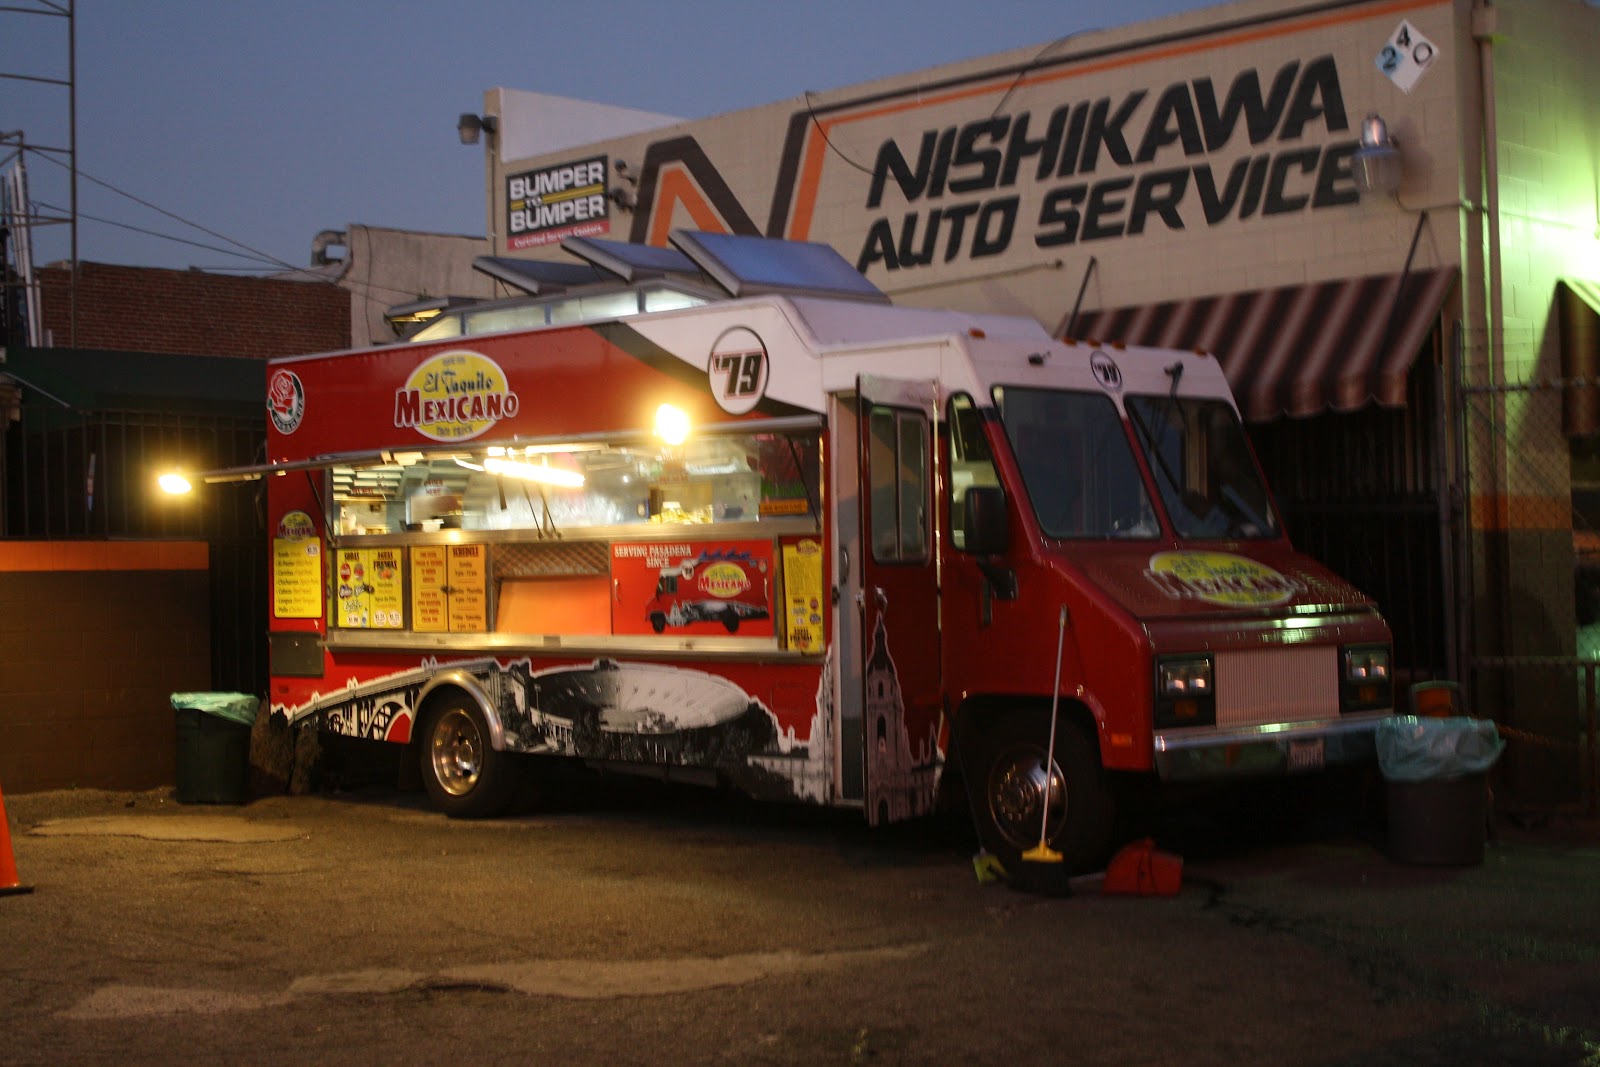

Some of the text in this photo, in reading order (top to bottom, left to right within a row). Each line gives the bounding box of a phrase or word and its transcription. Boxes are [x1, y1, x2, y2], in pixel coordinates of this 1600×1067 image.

[1396, 24, 1410, 47] 4
[1382, 45, 1397, 70] 2
[865, 53, 1348, 209] NISHIKAWA
[509, 161, 604, 200] BUMPER
[510, 194, 604, 232] BUMPER
[525, 196, 542, 208] TO
[857, 140, 1361, 273] AUTO SERVICE
[423, 371, 439, 393] El
[614, 544, 692, 558] SERVING PASADENA
[646, 558, 670, 568] SINCE
